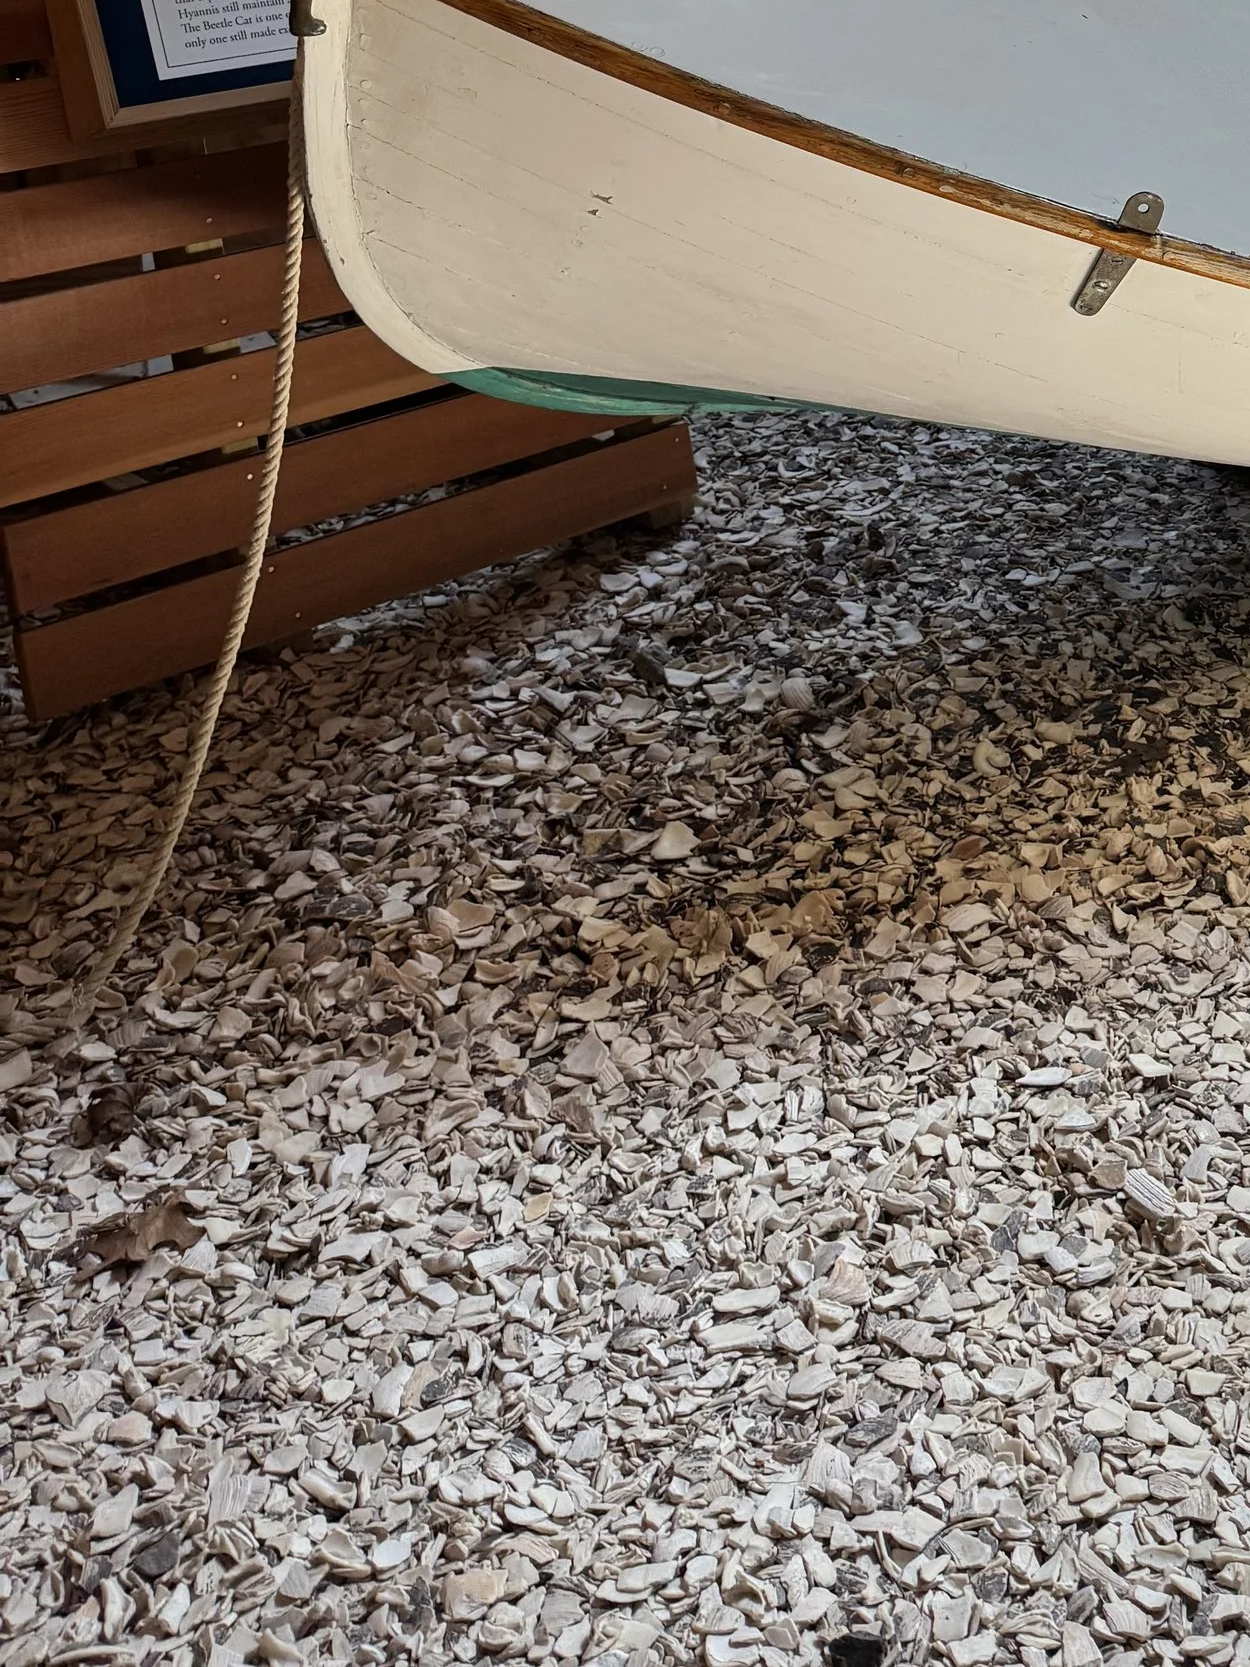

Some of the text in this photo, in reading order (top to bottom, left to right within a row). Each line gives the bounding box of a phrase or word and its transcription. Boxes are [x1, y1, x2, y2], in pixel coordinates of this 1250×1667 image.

[177, 5, 220, 21] Hyannis
[221, 0, 239, 13] still
[179, 13, 283, 34] The Beetle Cat one
[184, 25, 276, 49] only one still made
